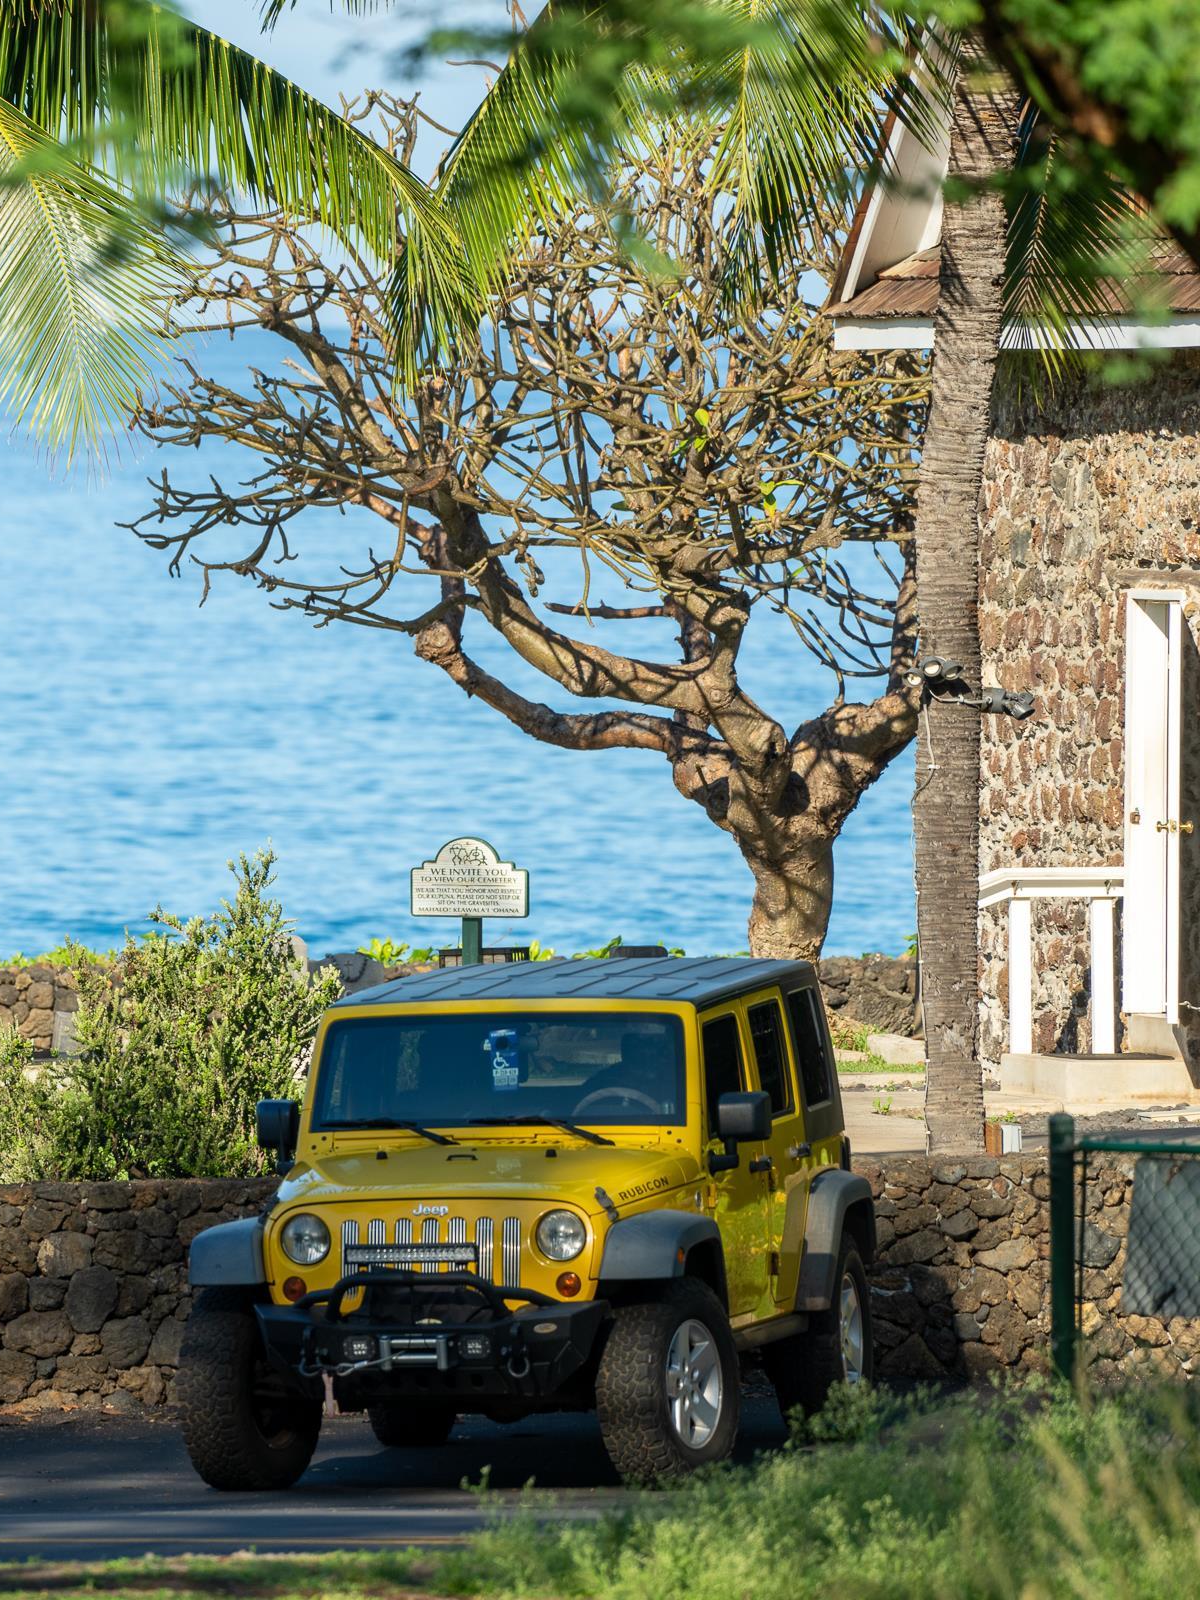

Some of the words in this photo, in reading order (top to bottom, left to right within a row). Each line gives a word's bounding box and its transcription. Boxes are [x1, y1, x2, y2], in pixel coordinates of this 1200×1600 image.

[431, 868, 446, 876] WE
[449, 868, 481, 876] INVITE
[484, 868, 508, 876] YOU
[618, 1175, 669, 1201] RUBICON
[412, 1203, 449, 1217] Jeep
